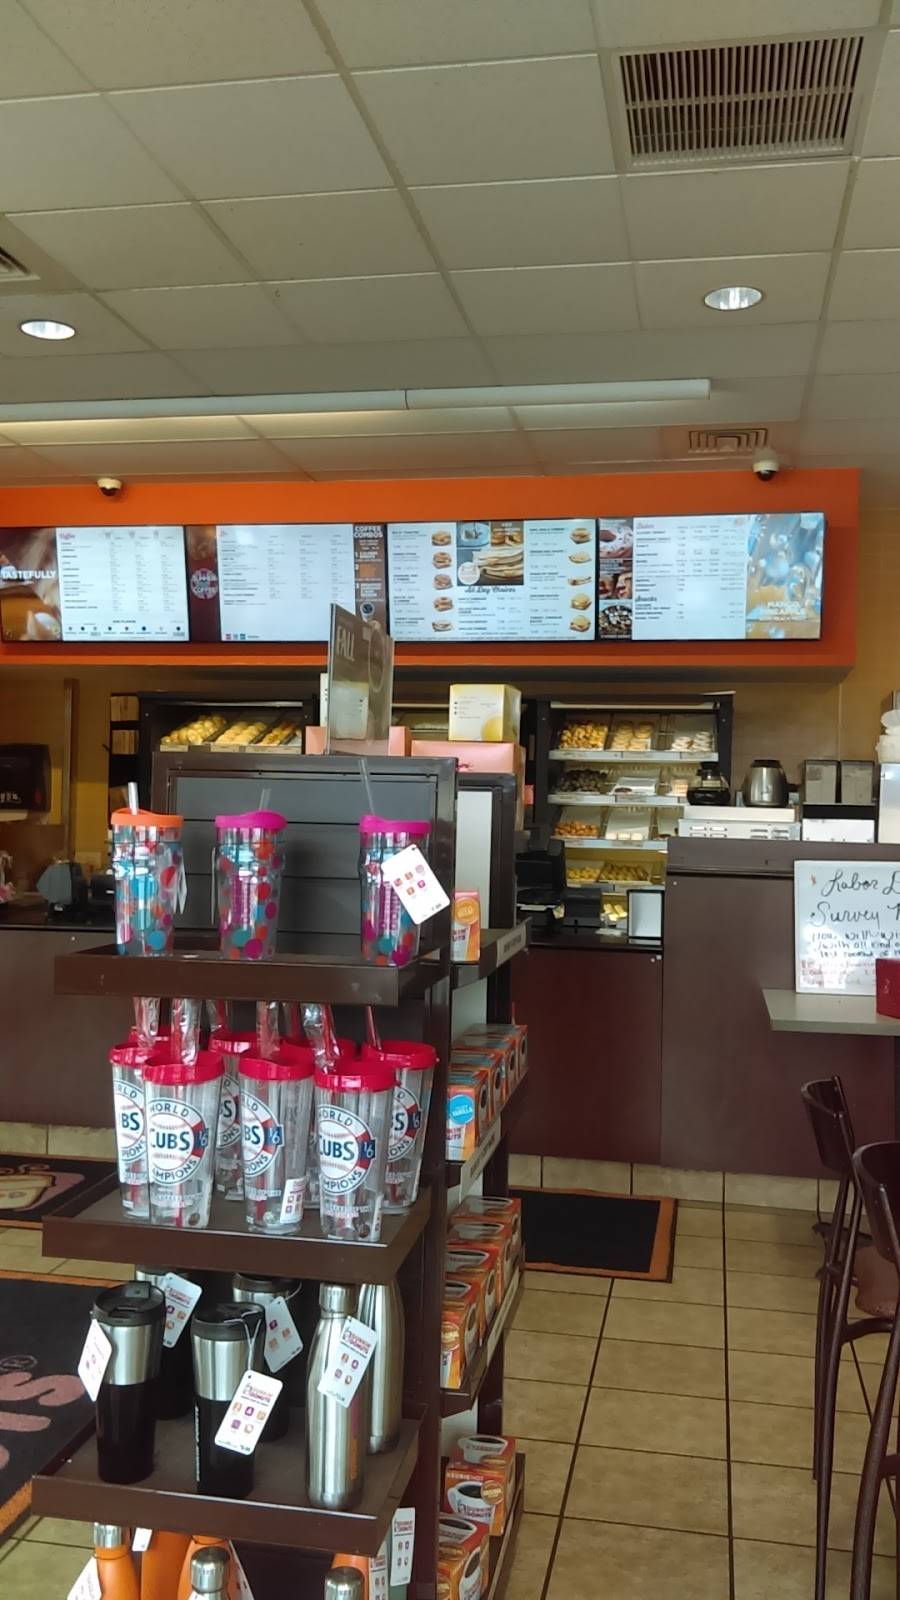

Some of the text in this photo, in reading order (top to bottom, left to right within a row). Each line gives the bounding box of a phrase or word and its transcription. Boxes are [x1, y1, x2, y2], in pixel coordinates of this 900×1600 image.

[1, 570, 56, 579] TASTEFULLY
[820, 869, 878, 897] Labor
[810, 901, 880, 928] Survey
